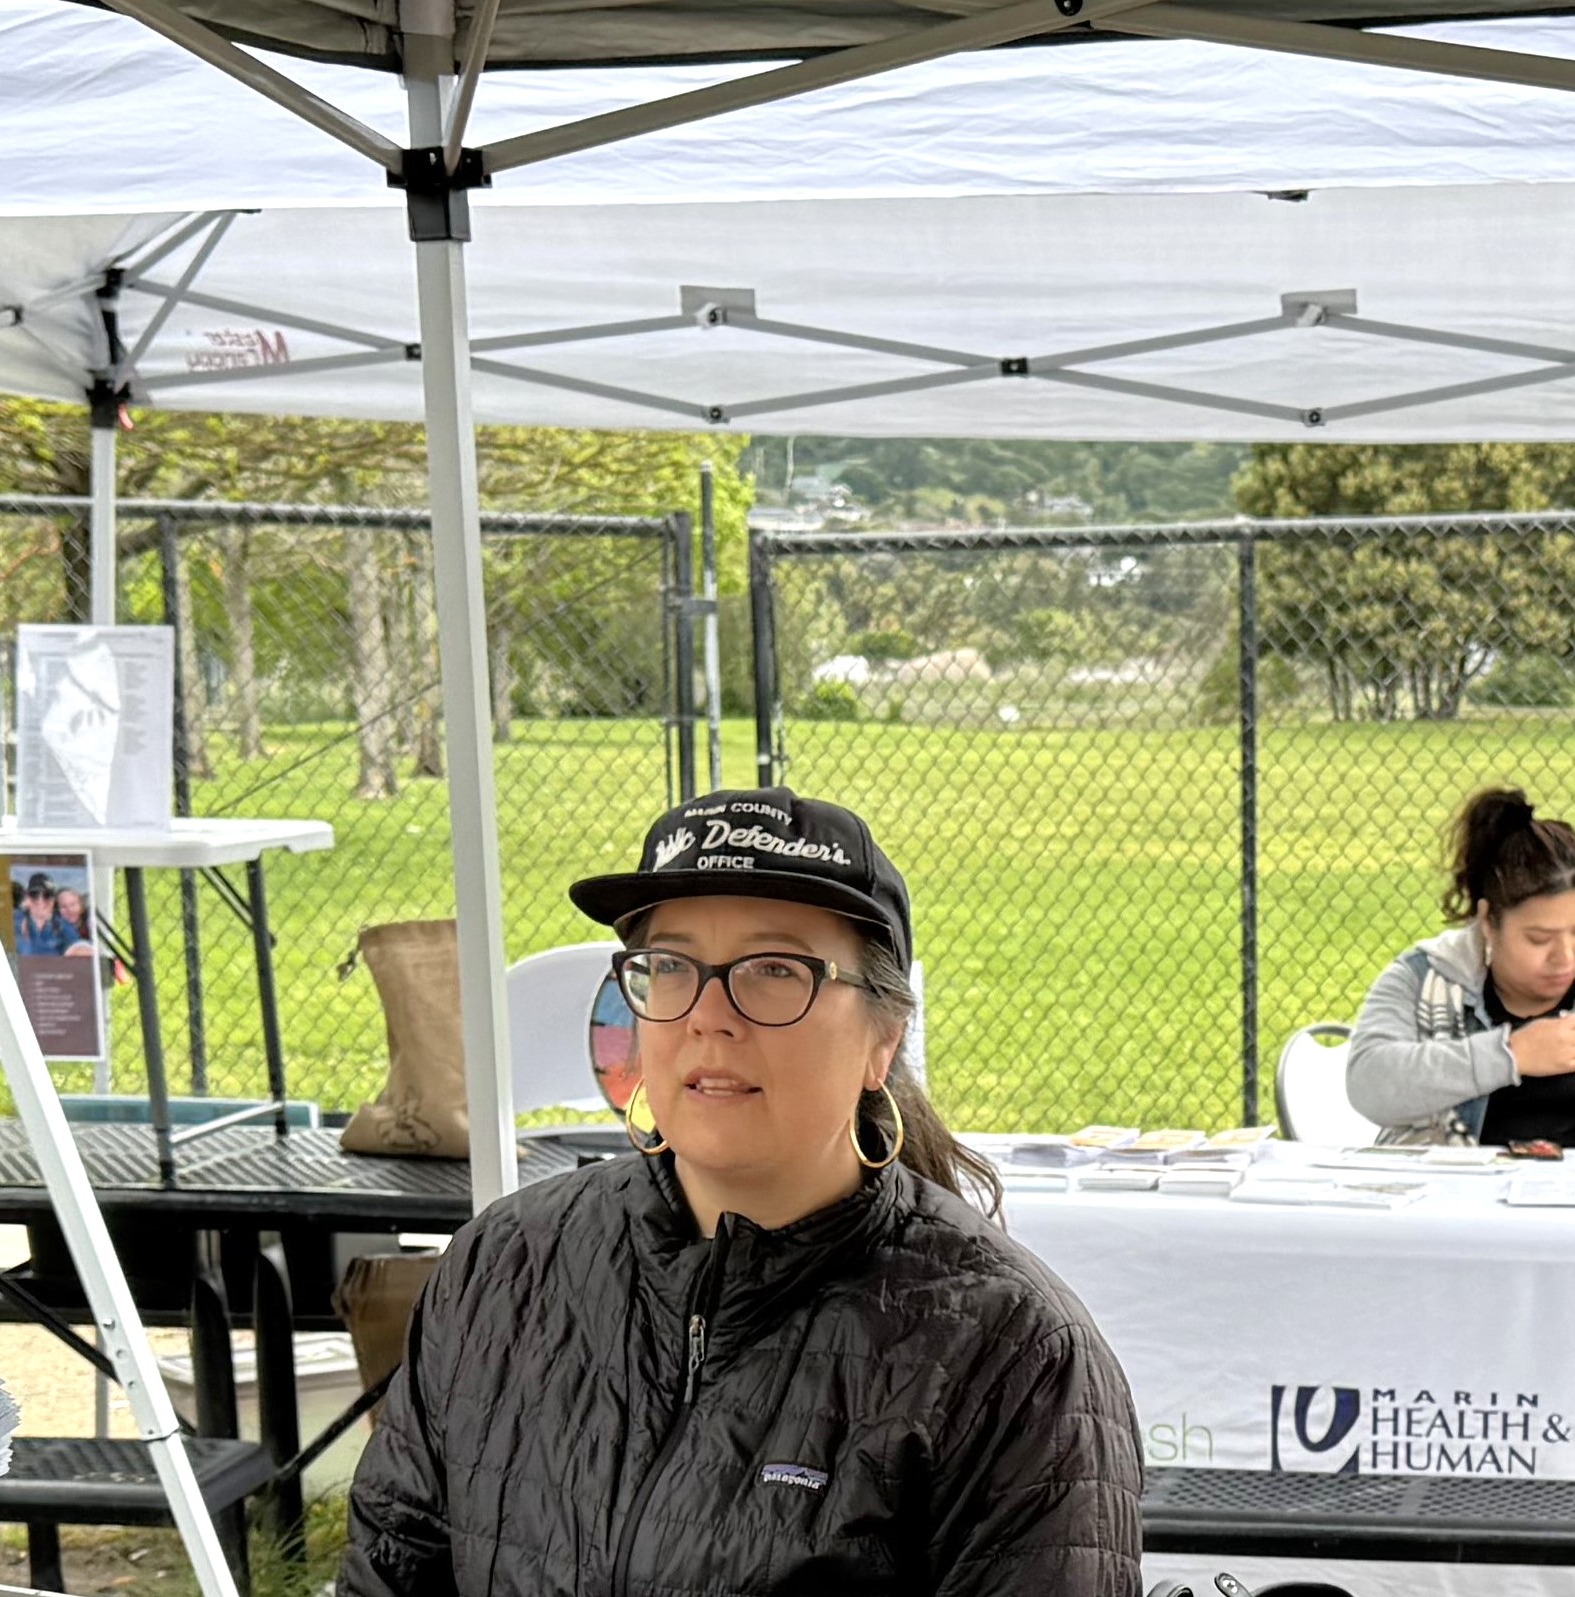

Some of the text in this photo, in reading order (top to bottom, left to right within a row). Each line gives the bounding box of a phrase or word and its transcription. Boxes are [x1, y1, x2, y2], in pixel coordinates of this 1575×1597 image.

[730, 801, 793, 825] COUNTY
[697, 855, 754, 871] OFFICE
[1372, 1387, 1540, 1409] MARIN
[1371, 1405, 1573, 1445] HEALTH &
[1370, 1442, 1538, 1476] HUMAN
